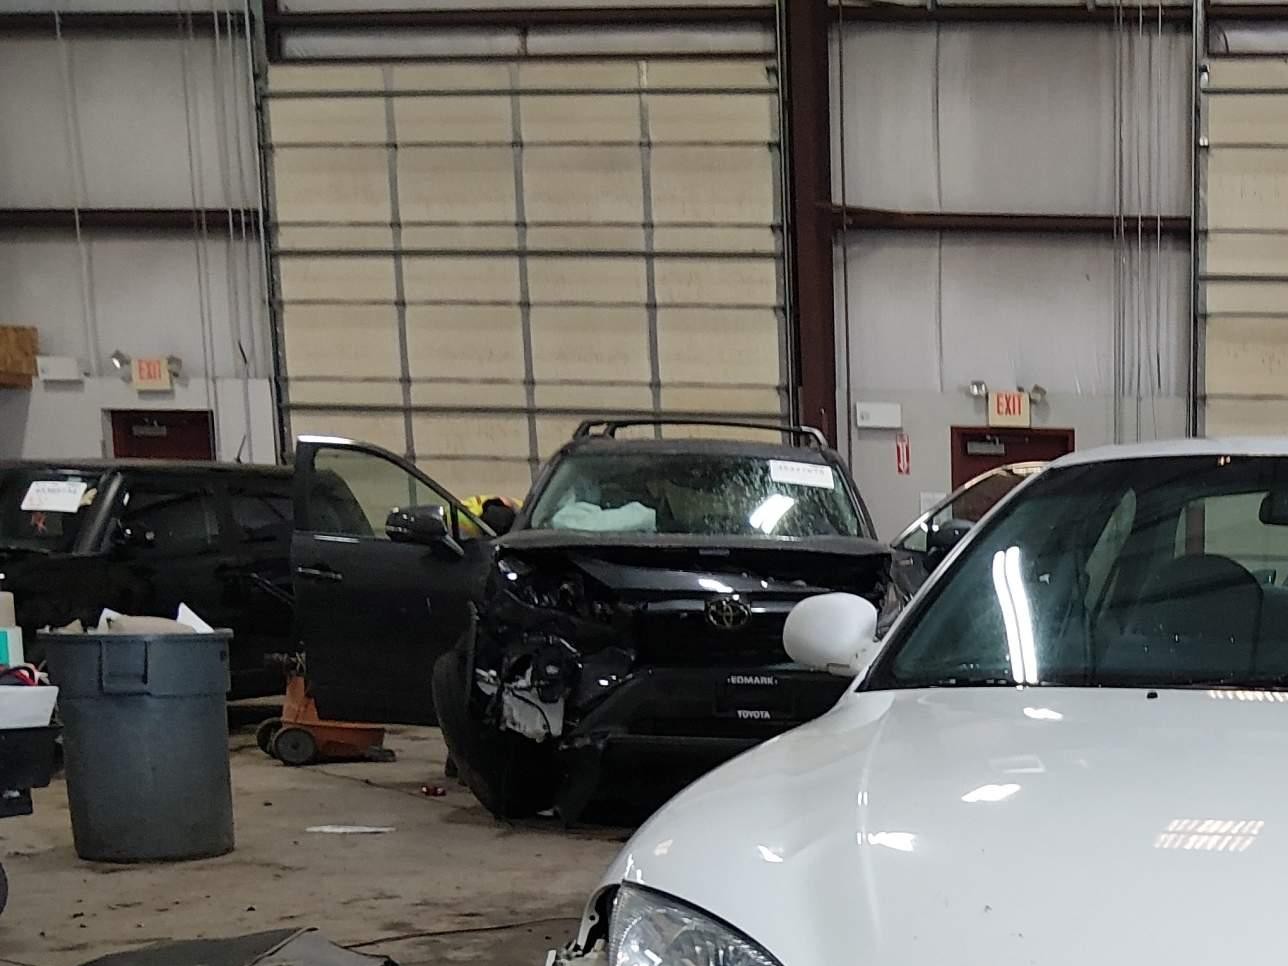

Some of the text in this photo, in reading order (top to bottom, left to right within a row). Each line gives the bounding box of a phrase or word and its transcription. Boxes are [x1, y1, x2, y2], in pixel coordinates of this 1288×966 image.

[137, 359, 162, 380] EXIT
[997, 392, 1023, 416] EXIT
[731, 675, 774, 686] EDMARK
[737, 710, 771, 719] TOYOTA
